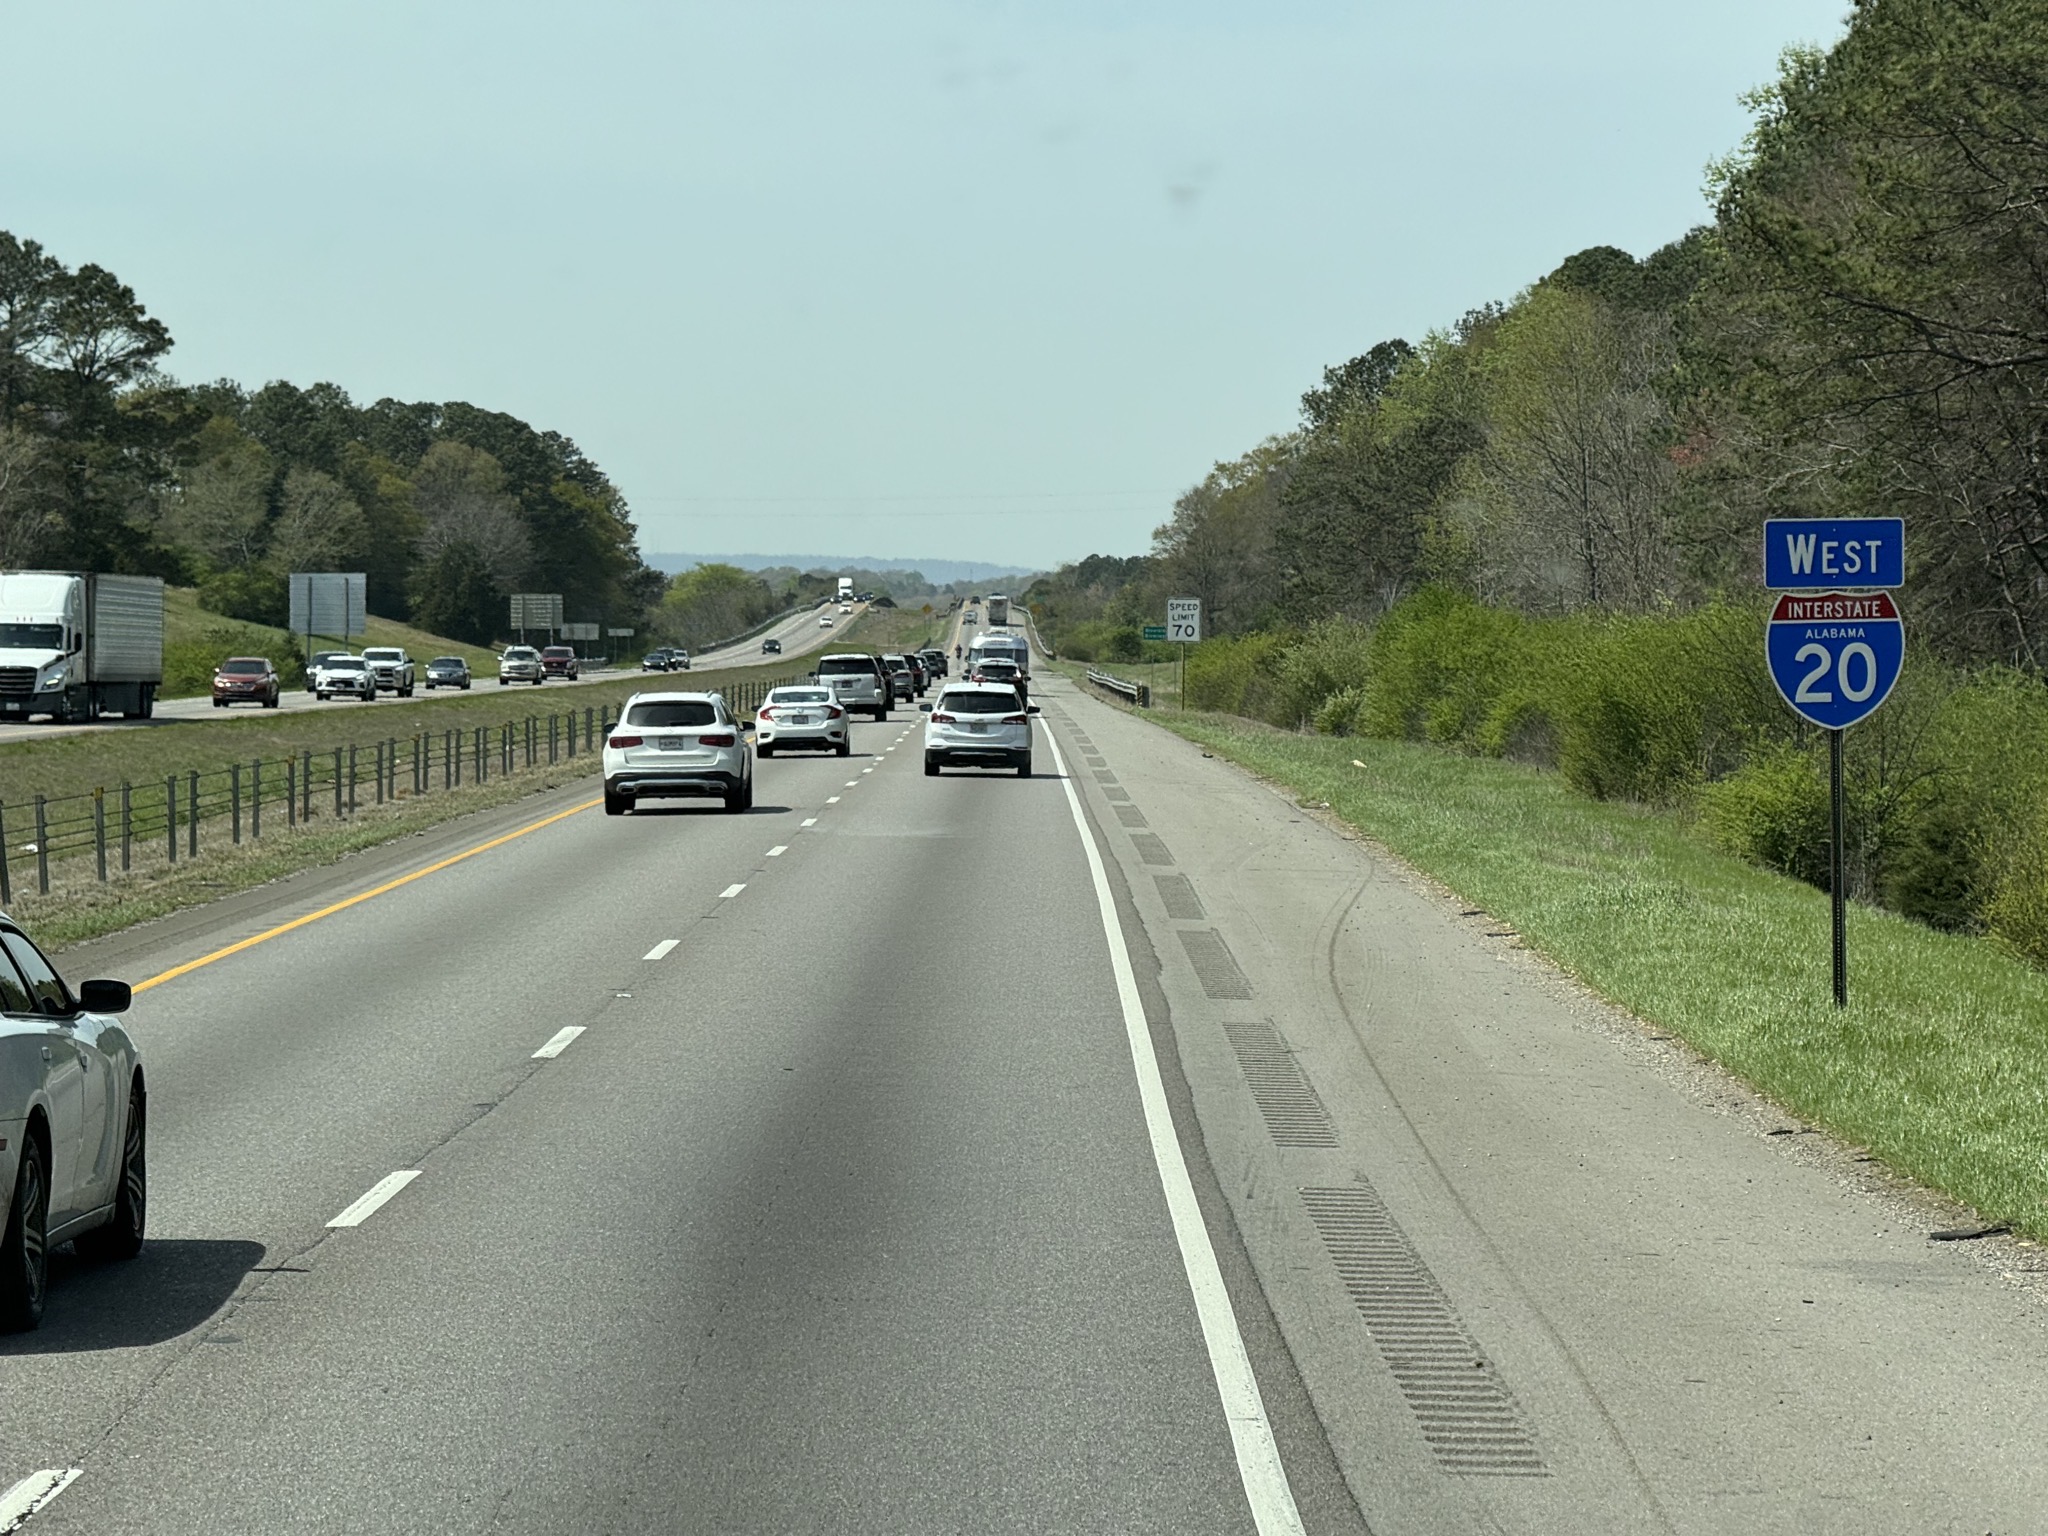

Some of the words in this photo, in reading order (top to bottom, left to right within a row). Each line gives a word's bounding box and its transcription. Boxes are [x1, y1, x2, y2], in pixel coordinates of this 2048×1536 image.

[1786, 534, 1881, 574] WEST
[1169, 603, 1198, 611] SPEED
[1788, 601, 1881, 618] INTERSTATE
[1172, 624, 1195, 637] 70
[1805, 628, 1865, 639] ALABAMA
[1794, 642, 1877, 703] 20
